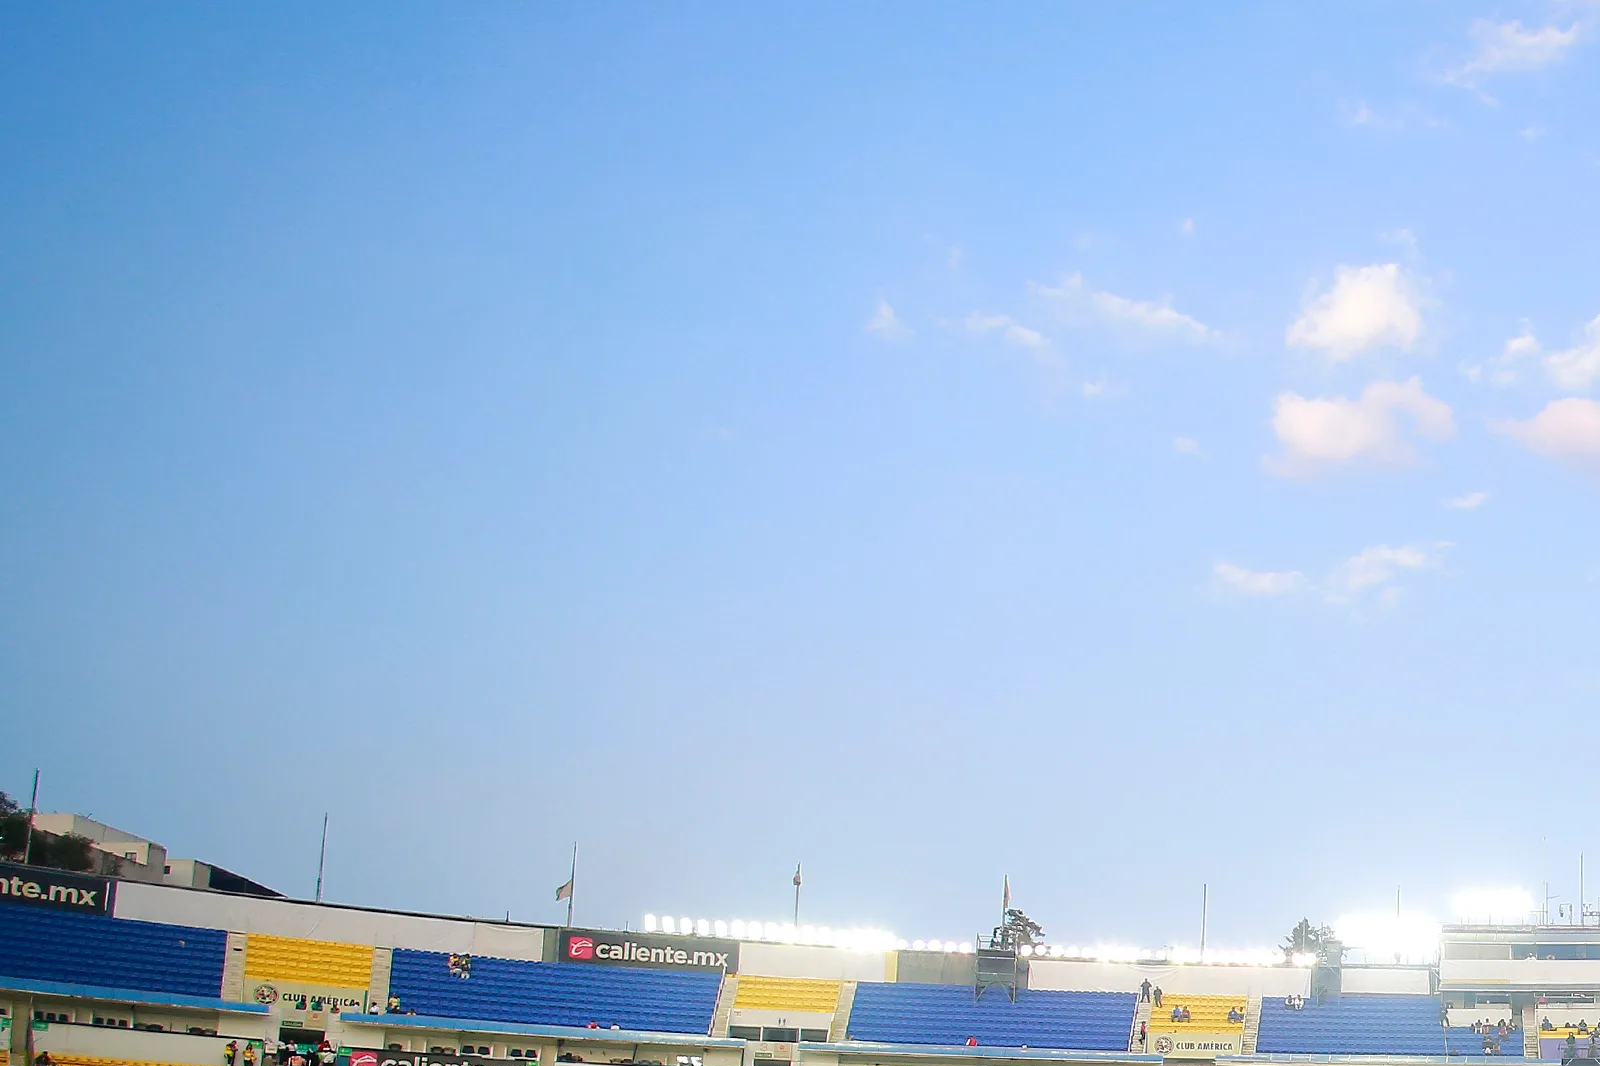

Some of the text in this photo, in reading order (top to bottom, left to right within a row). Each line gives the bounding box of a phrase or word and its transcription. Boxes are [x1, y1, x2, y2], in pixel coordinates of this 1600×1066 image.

[595, 941, 729, 967] caliente.mx
[1176, 1040, 1233, 1051] CLUB AMÉRICA
